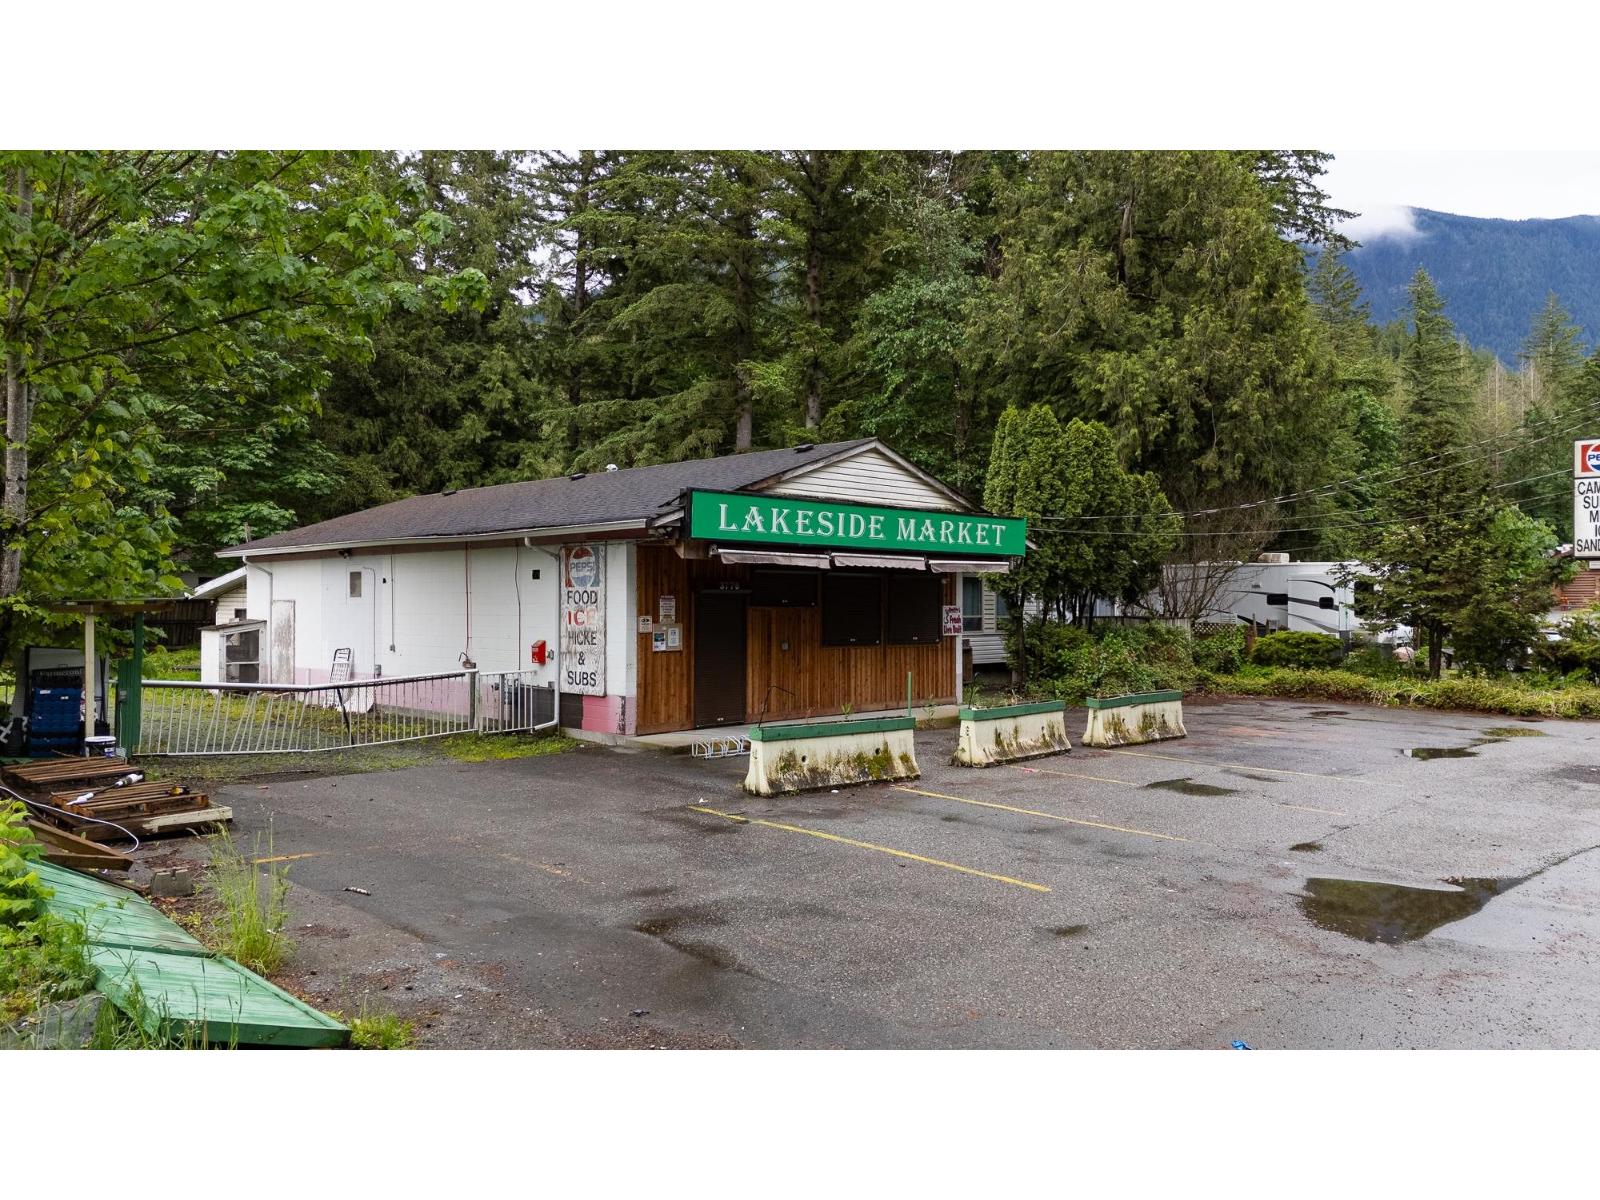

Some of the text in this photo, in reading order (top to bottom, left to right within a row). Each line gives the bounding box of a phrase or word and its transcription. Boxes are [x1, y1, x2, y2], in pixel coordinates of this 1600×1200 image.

[1583, 496, 1599, 509] SU
[718, 503, 1006, 546] LAKESIDE MARKET
[567, 590, 597, 604] FOOD
[578, 651, 585, 665] &
[567, 671, 597, 687] SUBS
